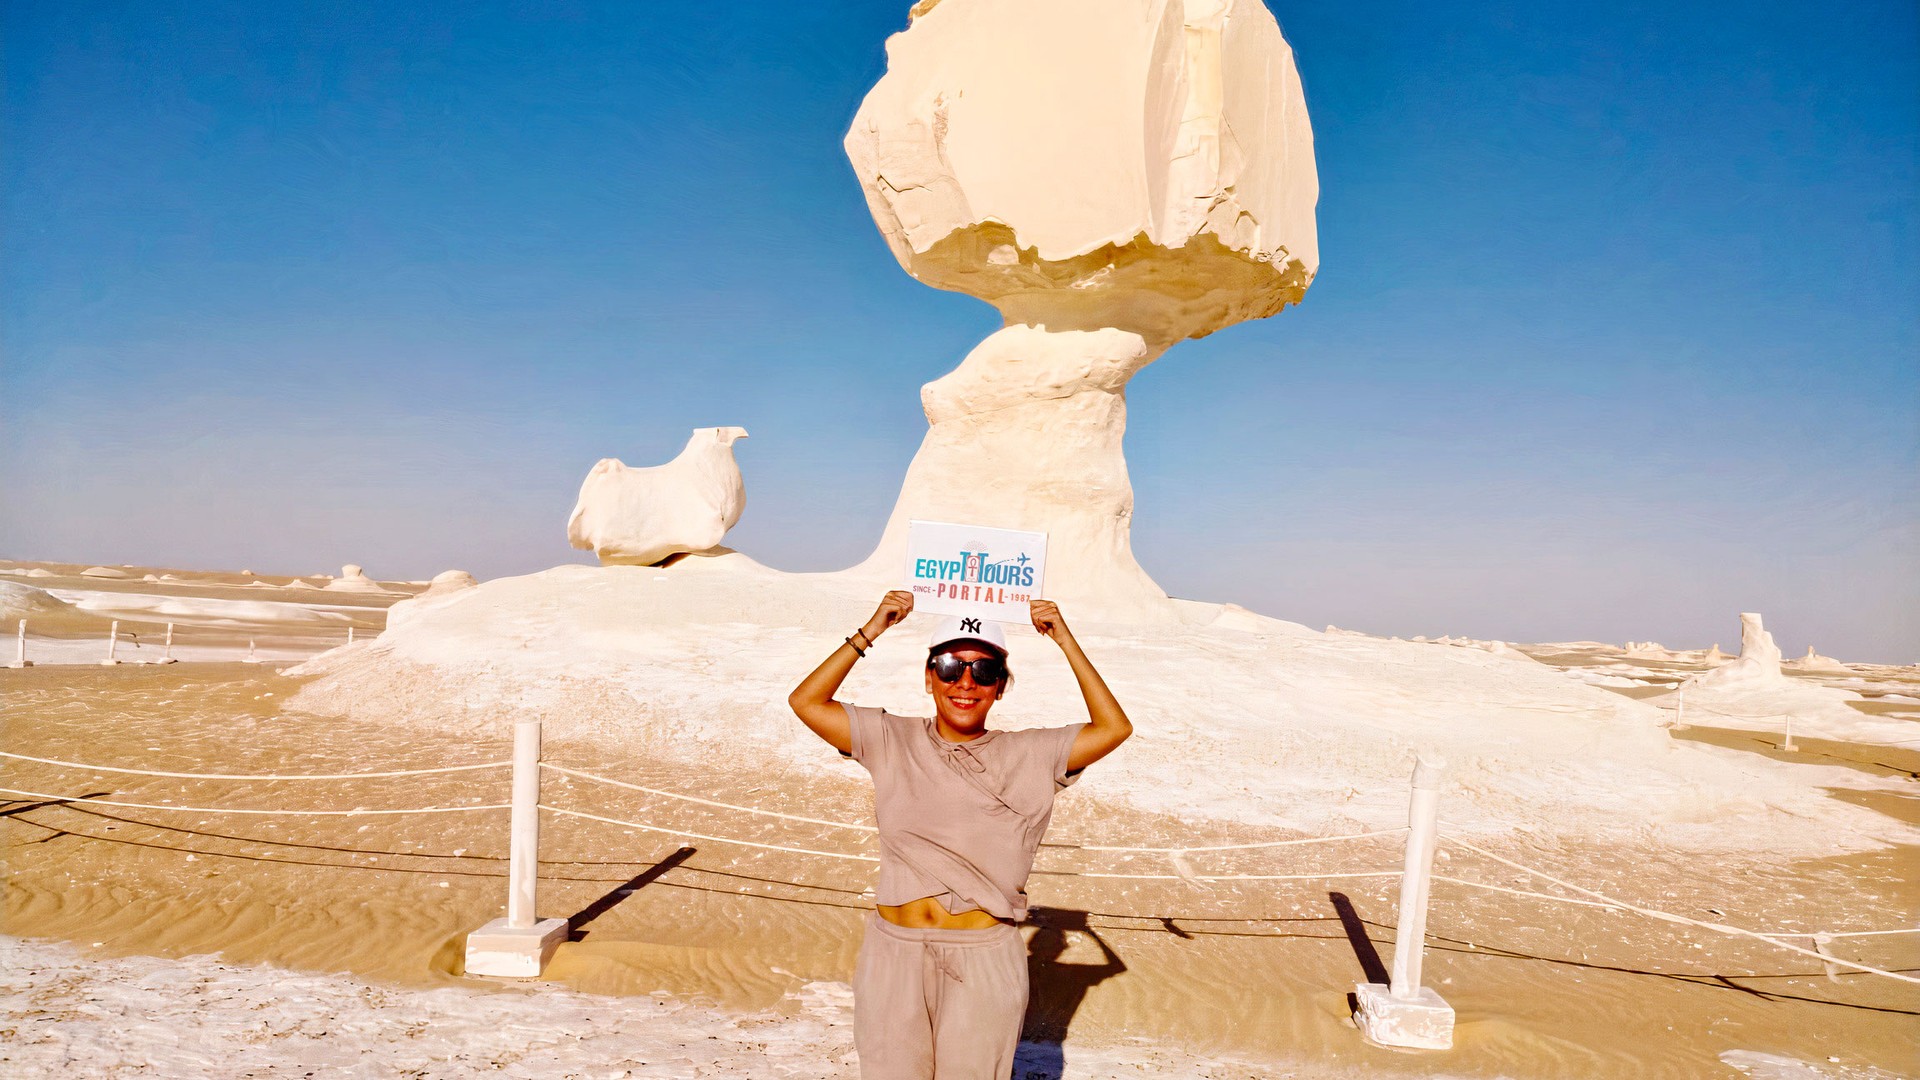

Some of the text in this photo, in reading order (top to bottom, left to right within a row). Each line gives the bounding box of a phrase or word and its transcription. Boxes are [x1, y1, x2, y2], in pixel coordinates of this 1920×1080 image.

[915, 551, 1034, 587] EGYPT TOURS
[937, 583, 1005, 604] PORTAL
[960, 617, 982, 634] NY
